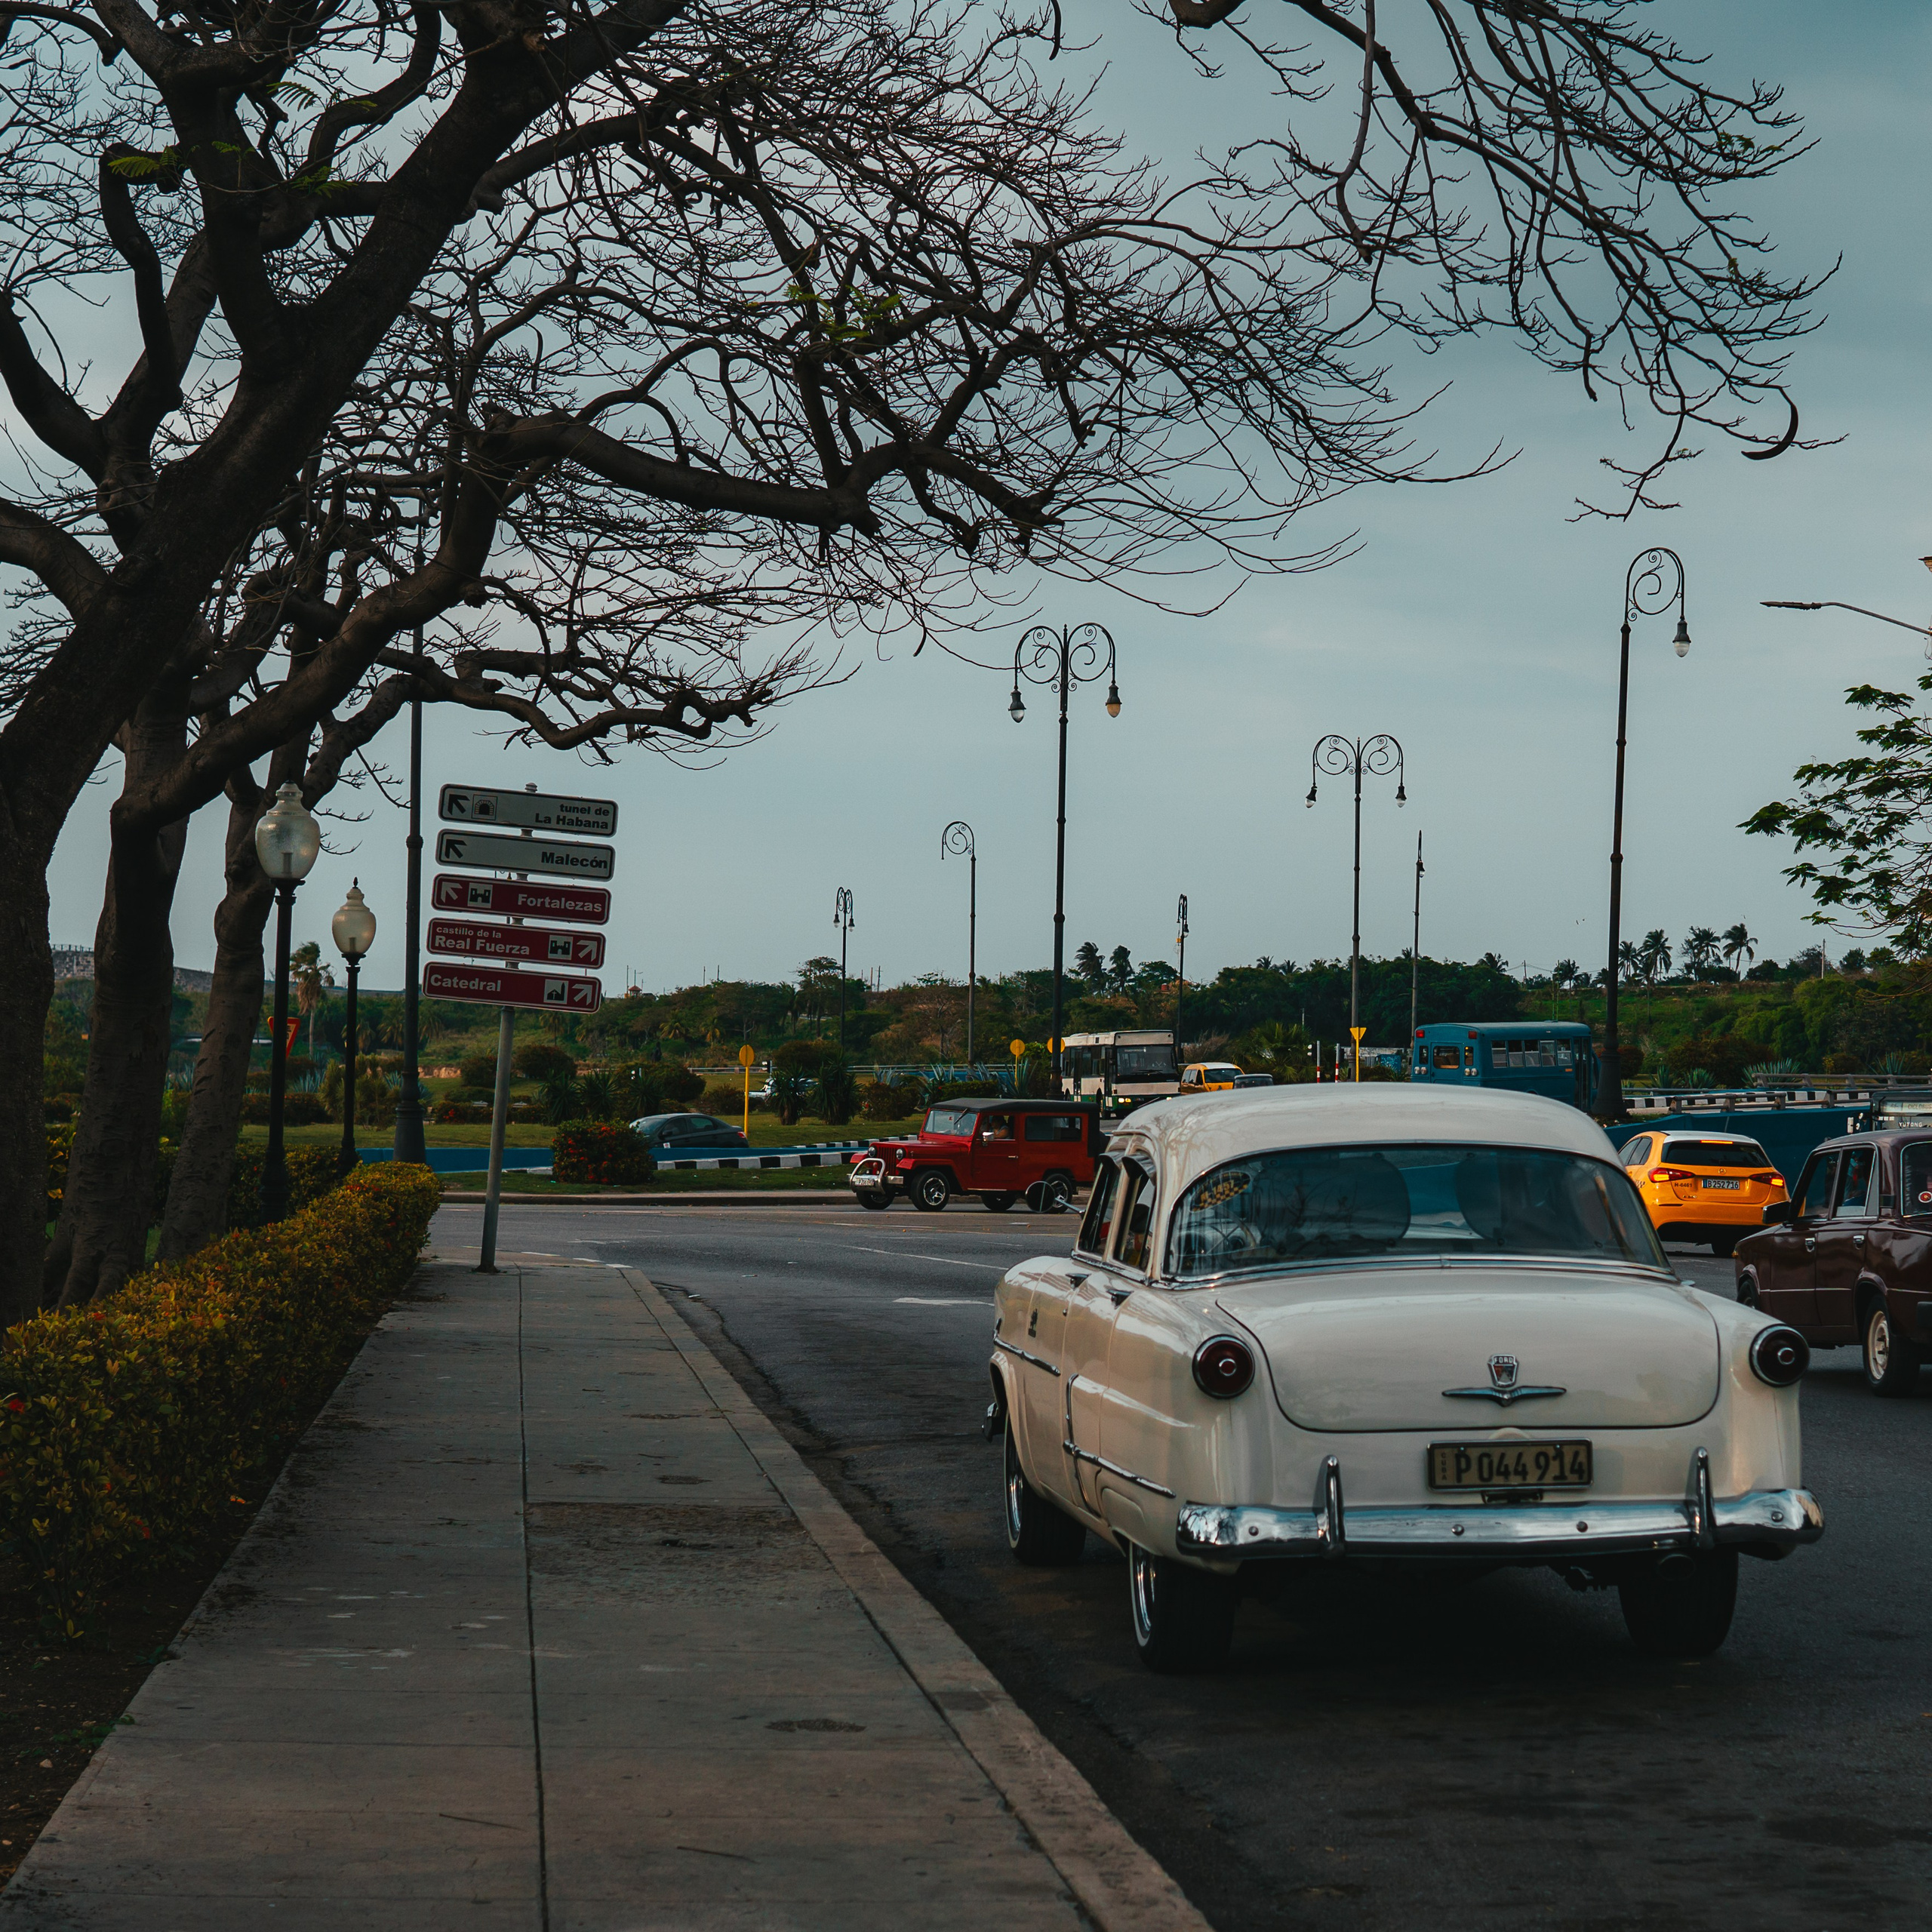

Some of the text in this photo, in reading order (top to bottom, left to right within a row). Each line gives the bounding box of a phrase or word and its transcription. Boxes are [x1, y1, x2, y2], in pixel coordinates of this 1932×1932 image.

[559, 802, 610, 817] tunel de
[534, 812, 608, 830] La Habana
[540, 851, 608, 869] Malecón
[517, 893, 602, 912] Fortalezas
[436, 927, 502, 939] castillo de la
[435, 935, 530, 955] Real Fuerza
[430, 974, 501, 992] Catedral
